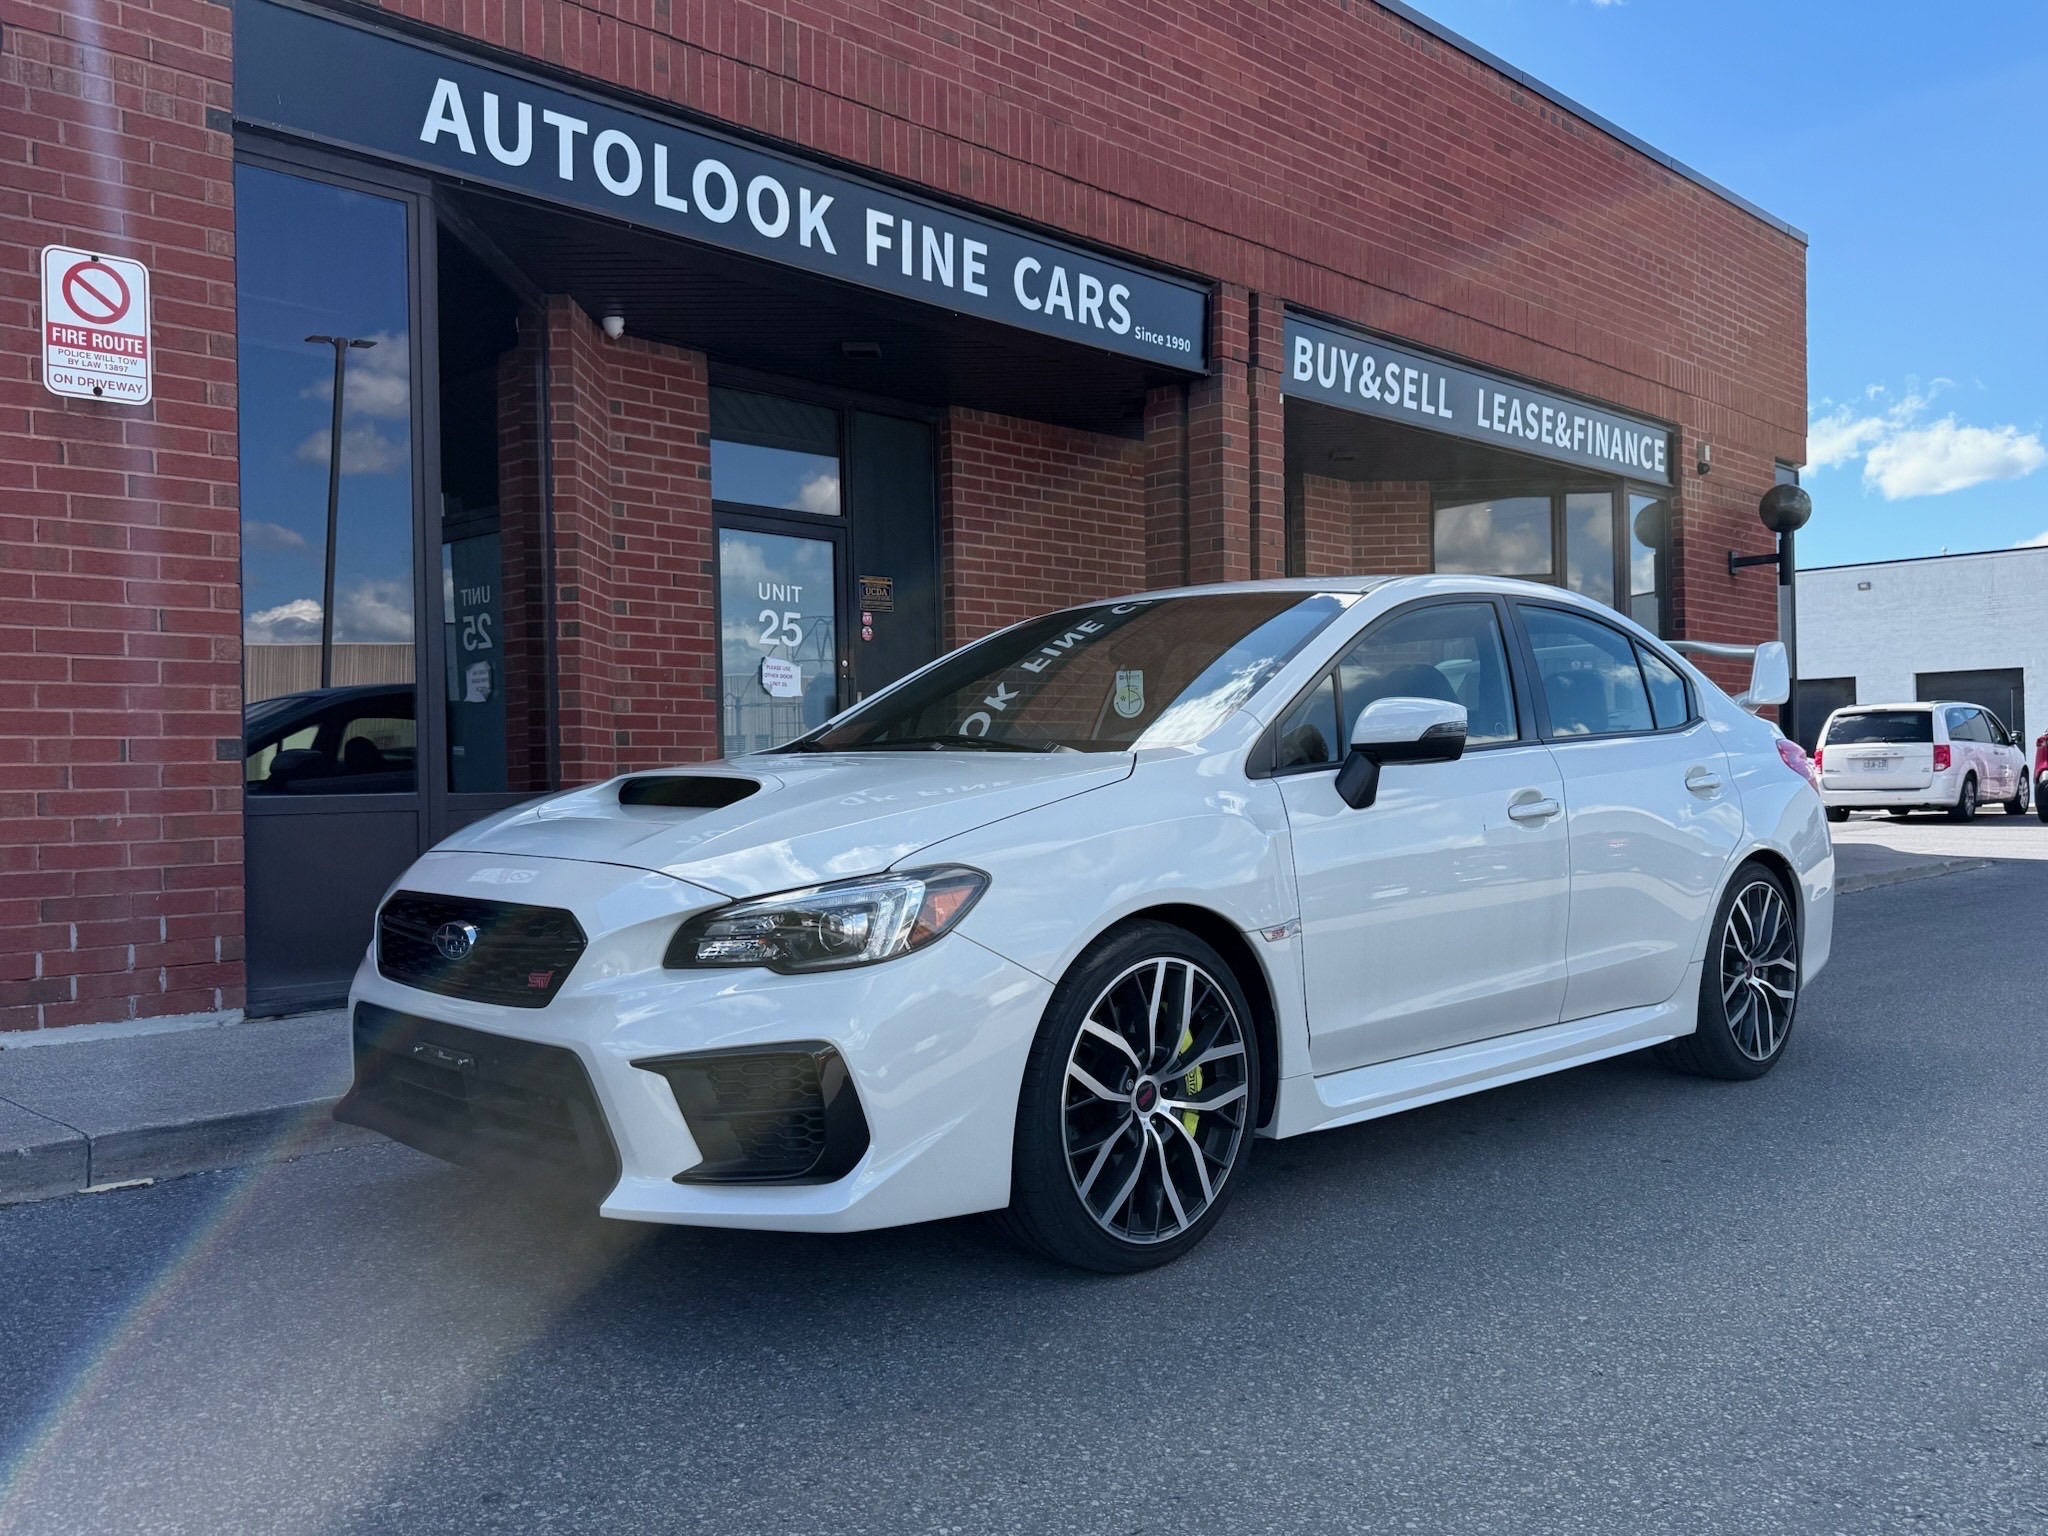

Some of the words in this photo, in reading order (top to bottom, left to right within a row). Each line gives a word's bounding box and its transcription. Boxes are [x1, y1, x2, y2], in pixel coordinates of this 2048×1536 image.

[419, 78, 837, 255] AUTOLOOK
[866, 207, 988, 297] FINE
[1014, 256, 1131, 335] CARS
[52, 326, 87, 346] FIRE
[92, 332, 143, 354] ROUTE
[1134, 326, 1164, 346] Since
[1165, 335, 1191, 352] 1990
[58, 348, 91, 359] POLICE
[94, 353, 115, 363] WILL
[117, 356, 138, 366] TOW
[68, 358, 79, 366] BY
[82, 360, 101, 369] LAW
[104, 363, 128, 373] 13897
[53, 373, 73, 385] ON
[78, 376, 143, 394] DRIVEWAY
[1293, 335, 1452, 419] BUY&SELL
[1477, 388, 1665, 472] LEASE&FINANCE
[758, 582, 802, 603] UNIT
[865, 587, 888, 596] UCDA
[758, 609, 803, 647] 25
